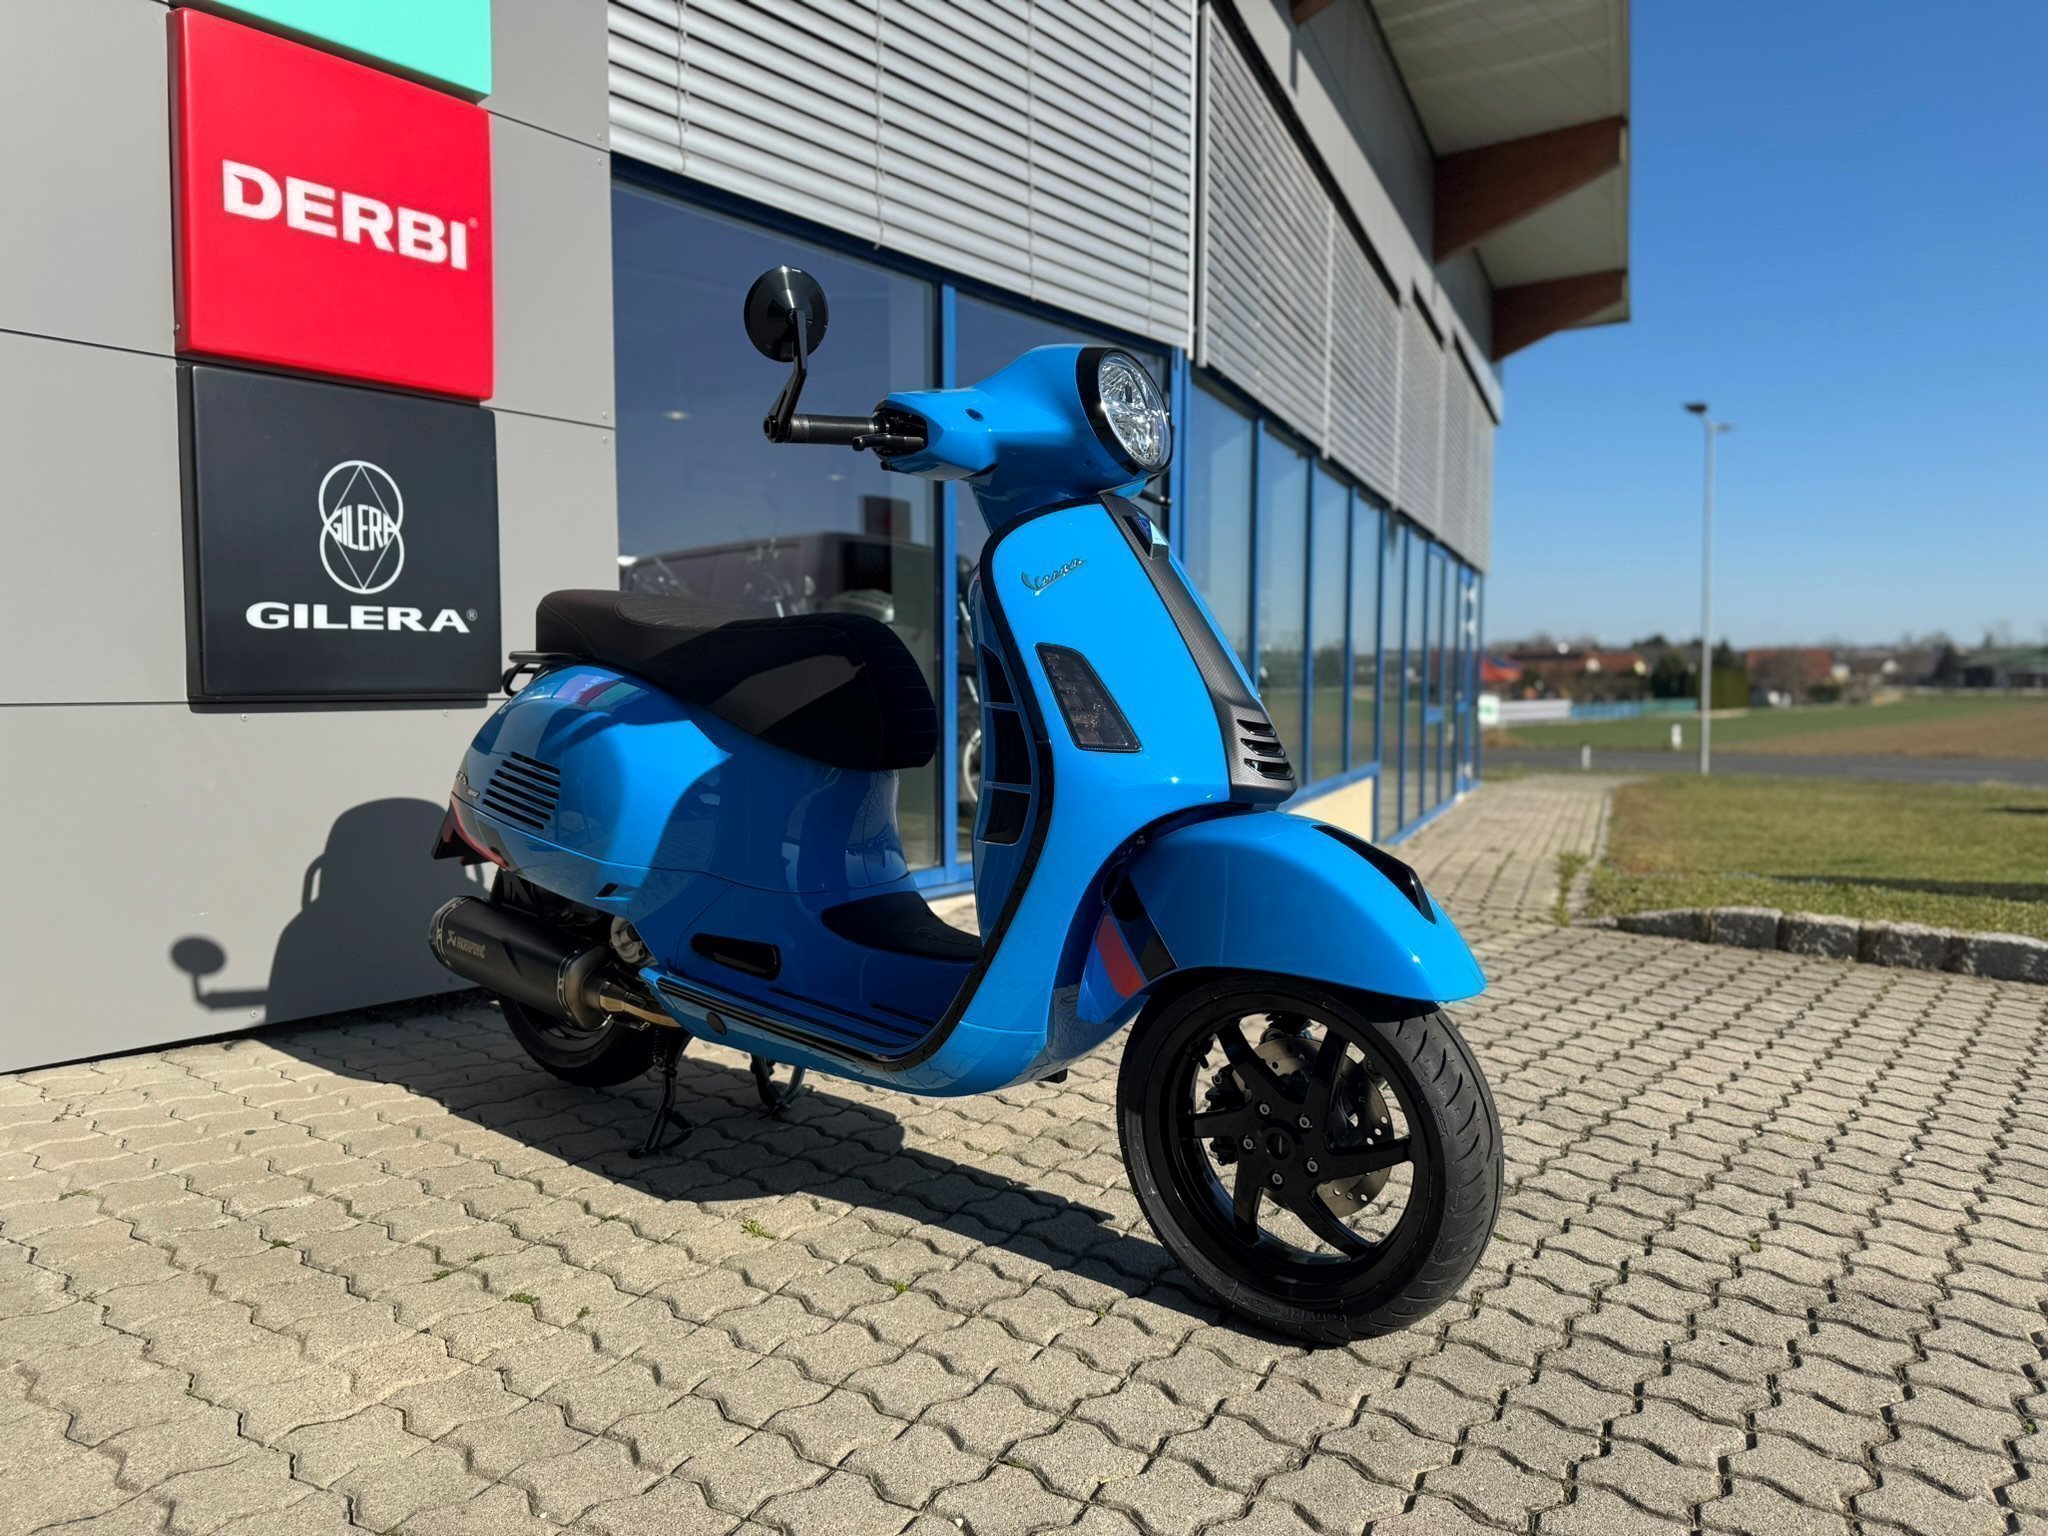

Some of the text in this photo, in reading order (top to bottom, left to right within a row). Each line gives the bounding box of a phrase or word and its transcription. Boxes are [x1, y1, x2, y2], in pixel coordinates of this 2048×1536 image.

[222, 159, 467, 270] DERBI
[326, 504, 399, 551] GILERA
[246, 601, 470, 633] GILERA
